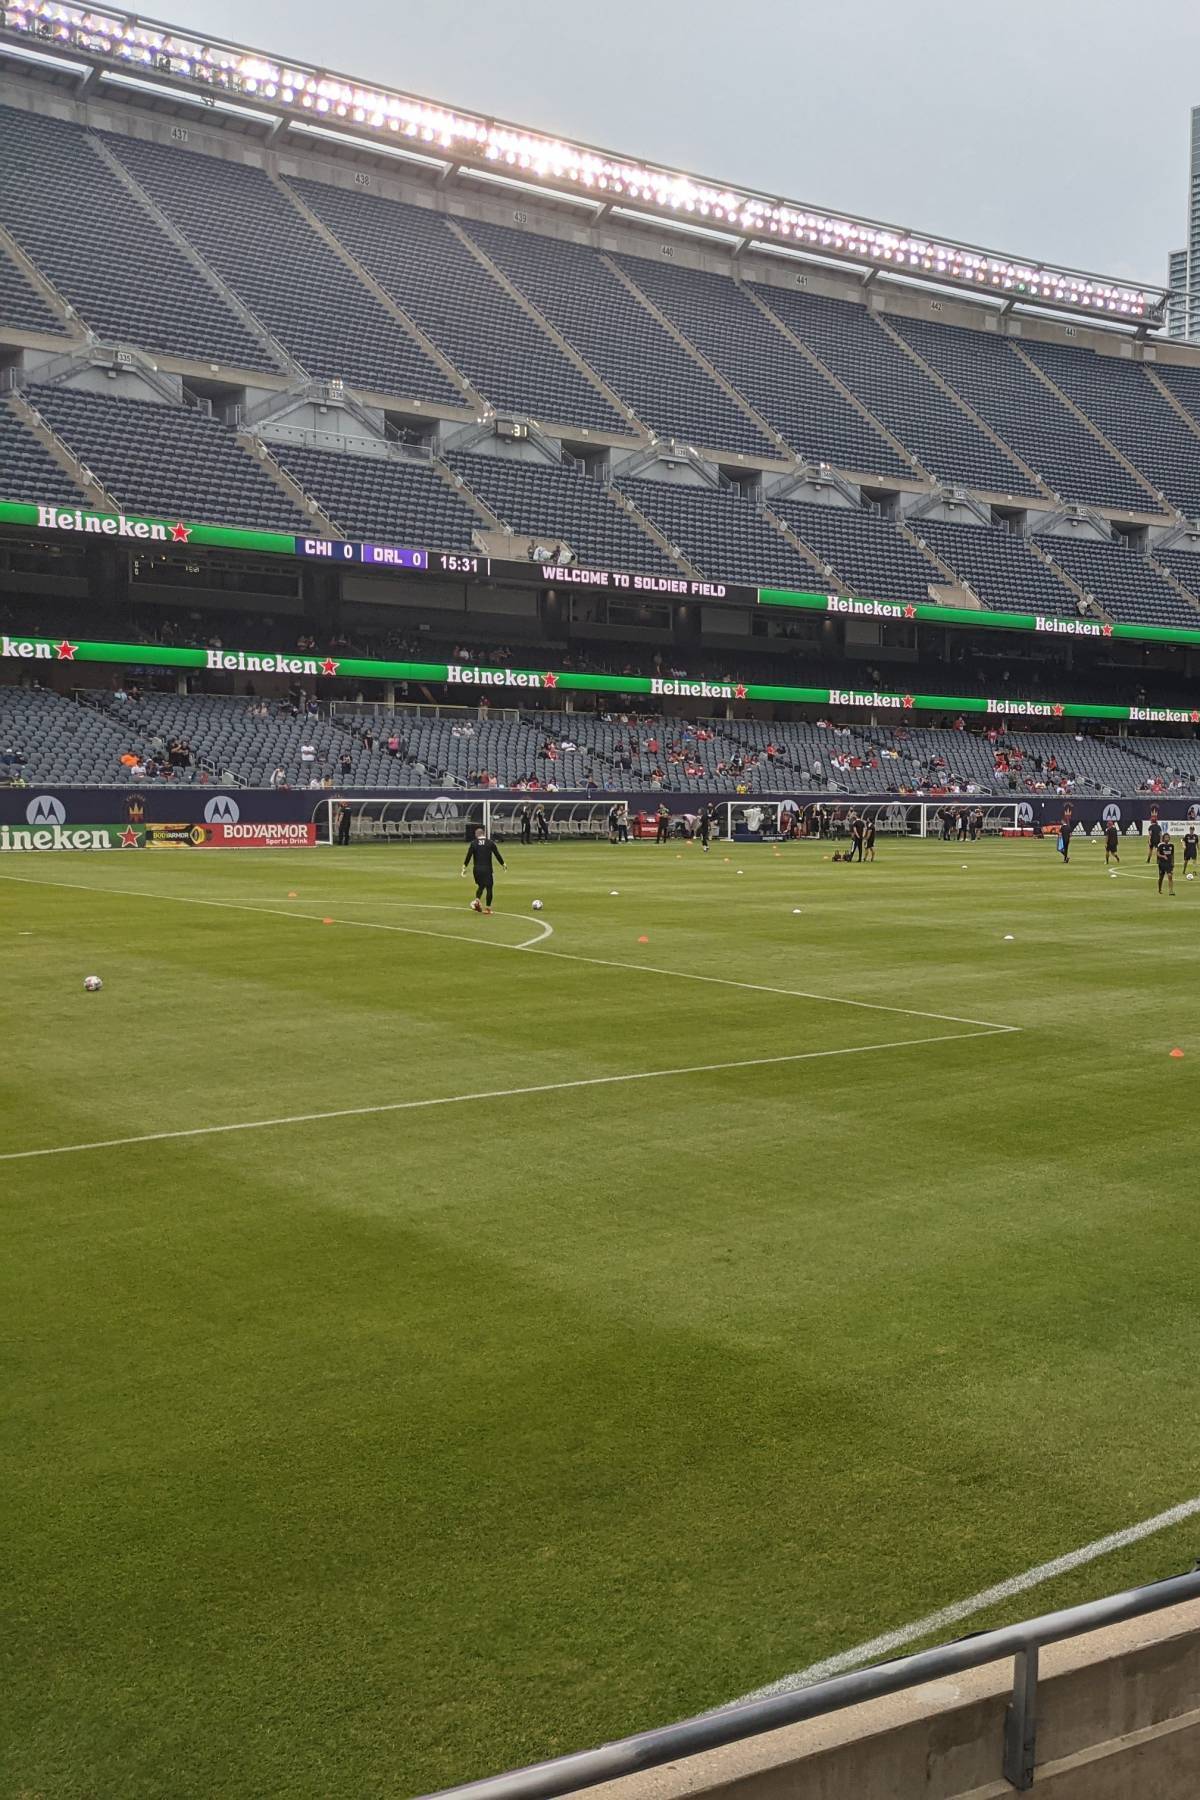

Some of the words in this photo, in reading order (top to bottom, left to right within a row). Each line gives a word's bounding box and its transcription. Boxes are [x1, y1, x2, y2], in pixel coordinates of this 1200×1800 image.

[170, 127, 188, 141] 437
[354, 173, 370, 187] 438
[513, 210, 528, 224] 439
[117, 352, 131, 363] 335
[37, 505, 167, 541] Heineken
[305, 540, 332, 557] CHI
[343, 545, 353, 559] 0
[373, 547, 403, 564] ORL
[412, 553, 421, 566] 0
[440, 556, 478, 573] 15:31
[542, 566, 608, 585] WELCOME
[613, 574, 630, 588] TO
[634, 576, 688, 594] SOLDIER
[691, 583, 726, 597] FIELD
[826, 596, 903, 619] Heineken
[1035, 617, 1100, 636] Heineken
[206, 650, 317, 675] Heineken
[446, 666, 540, 688] Heineken
[650, 678, 732, 698] Heineken
[828, 690, 901, 708] Heineken
[986, 700, 1052, 717] Heineken
[1129, 706, 1191, 722] Heineken
[152, 832, 189, 840] BODYARMOR
[223, 824, 308, 838] BODYARMOR
